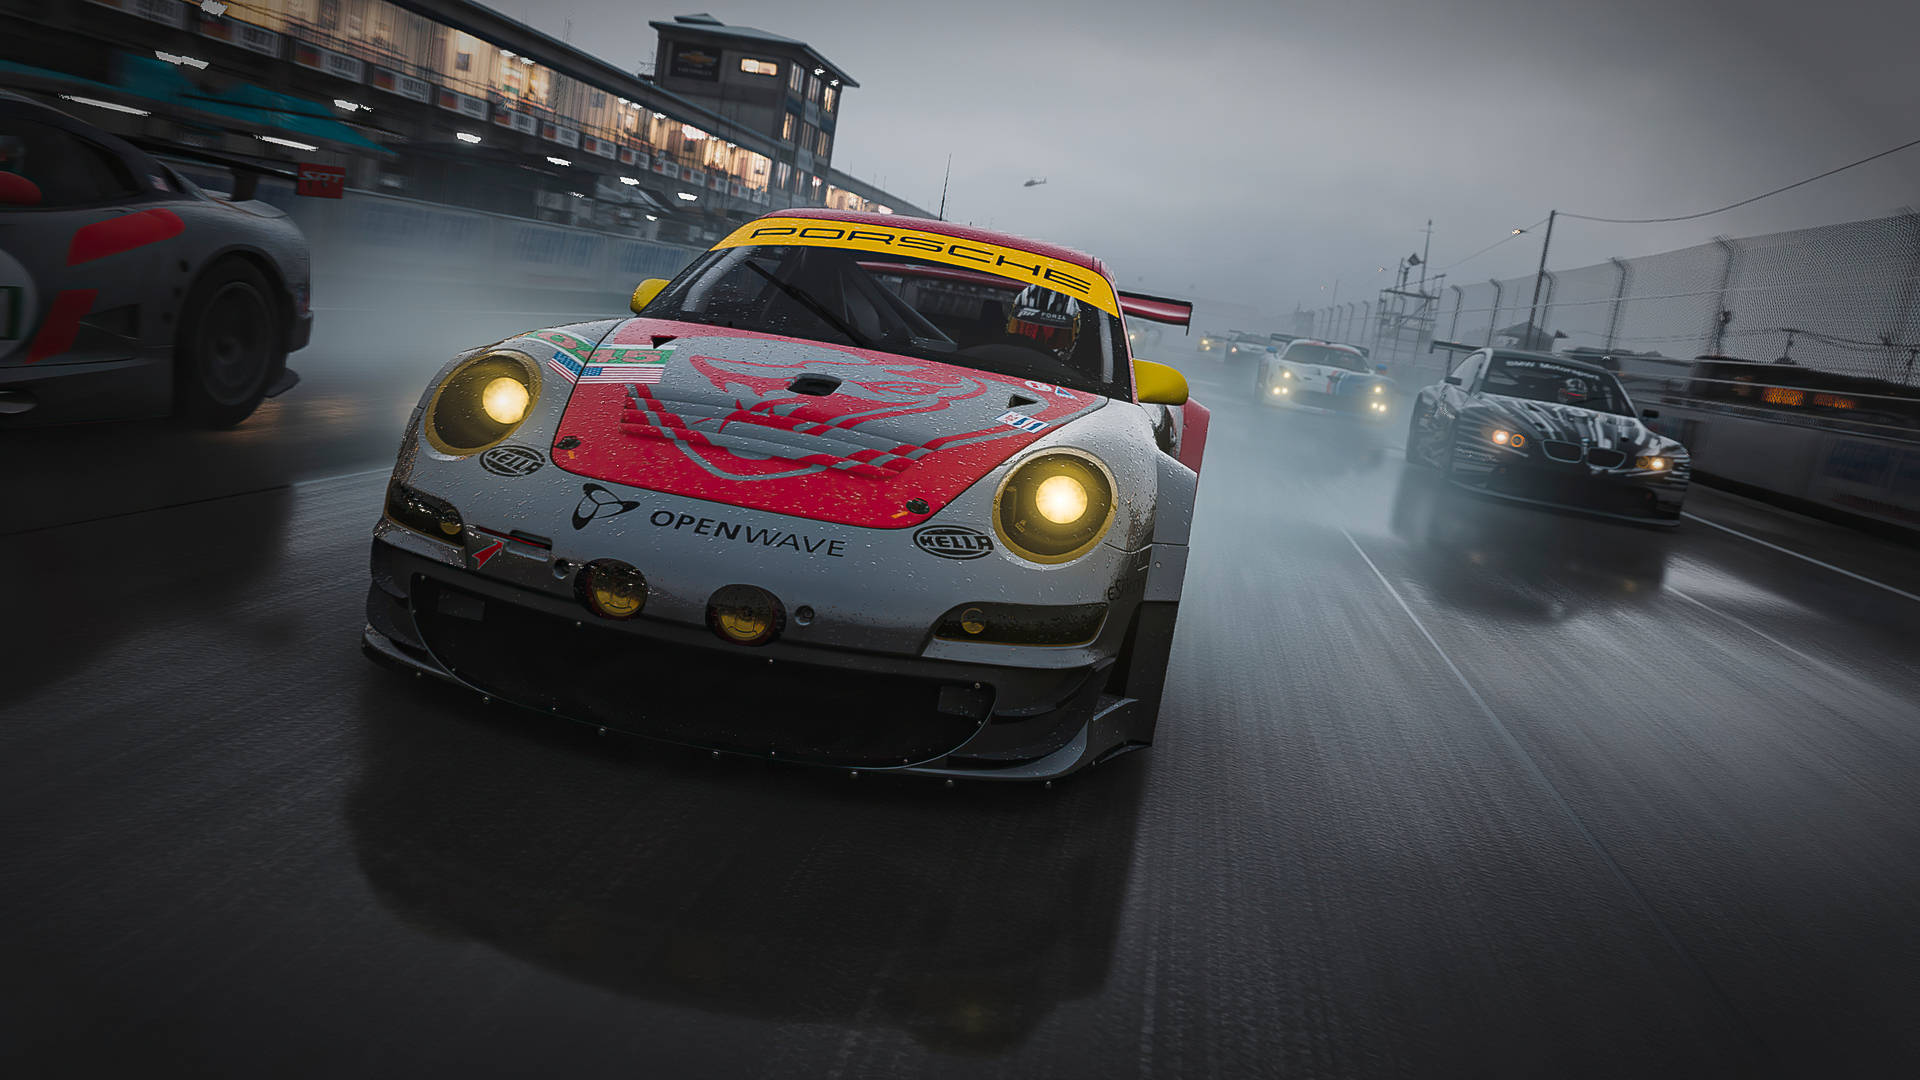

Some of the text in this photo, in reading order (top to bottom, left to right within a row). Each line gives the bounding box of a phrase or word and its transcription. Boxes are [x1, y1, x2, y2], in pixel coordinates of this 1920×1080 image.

[750, 227, 1091, 294] PORSCHE
[1041, 312, 1066, 320] FORZA
[485, 448, 545, 475] HELLA
[650, 510, 846, 557] OPENWAVE
[919, 534, 995, 551] HELLA
